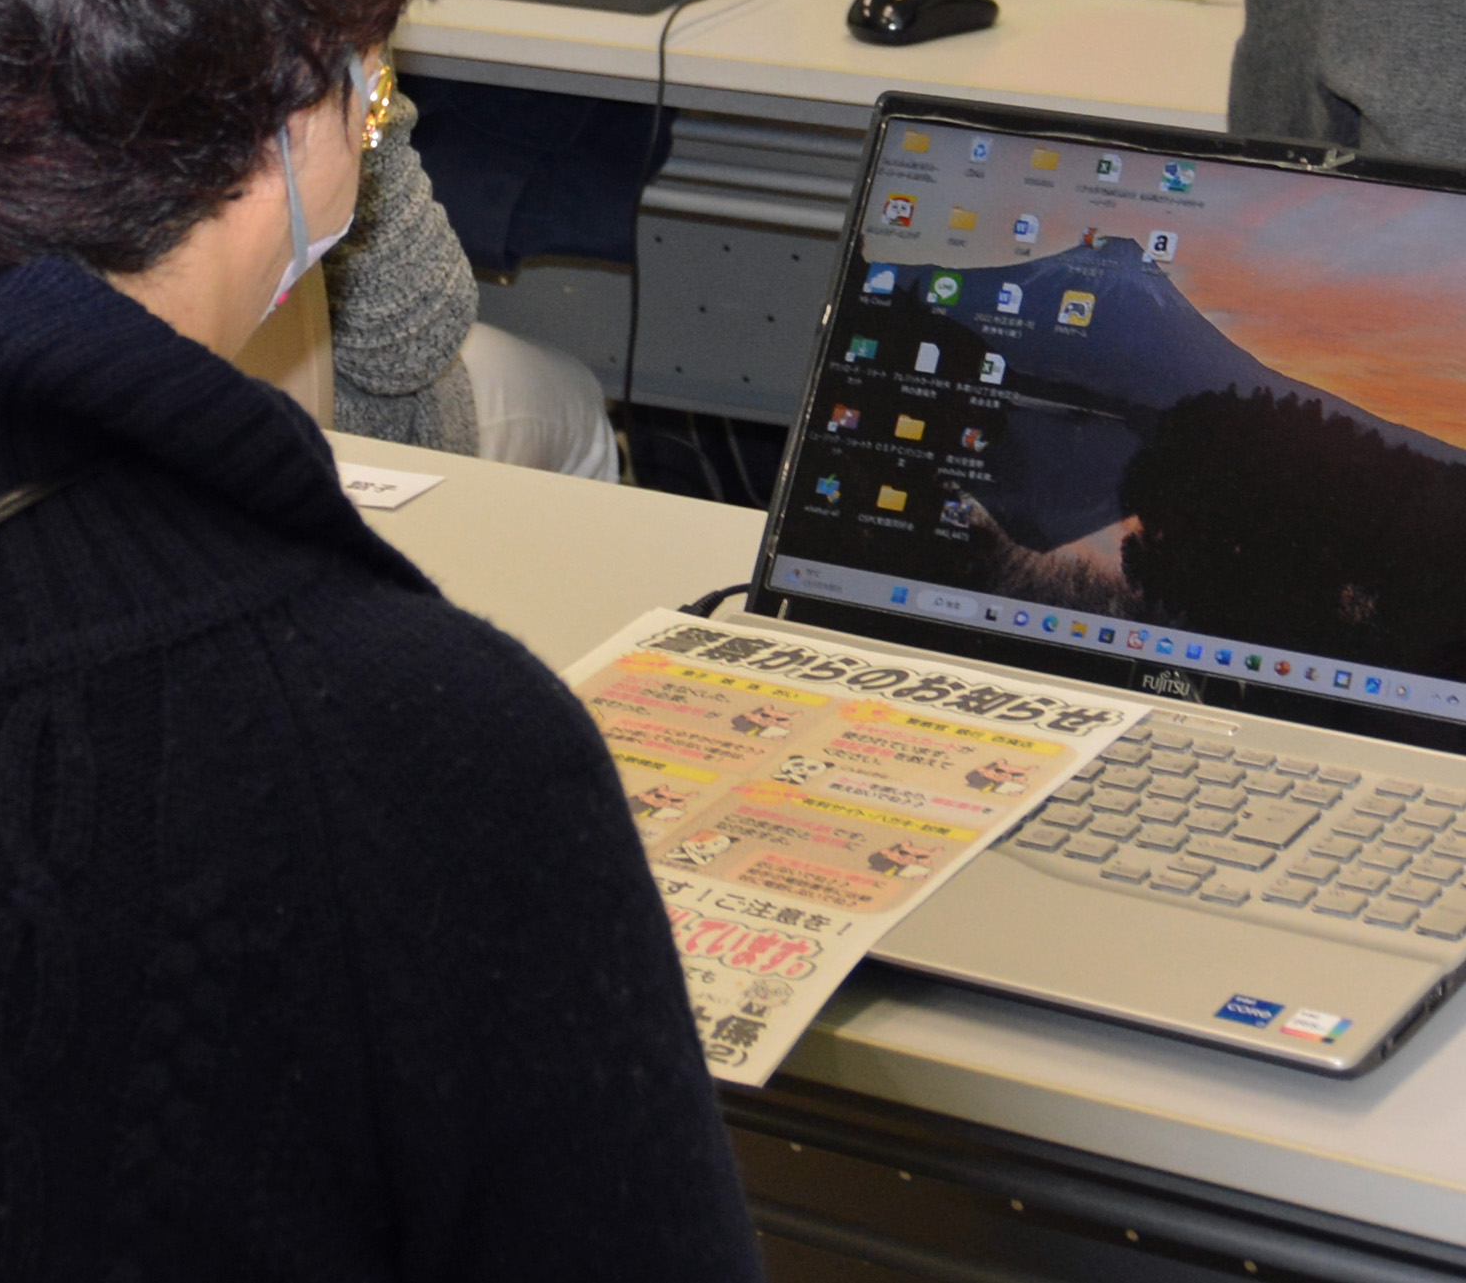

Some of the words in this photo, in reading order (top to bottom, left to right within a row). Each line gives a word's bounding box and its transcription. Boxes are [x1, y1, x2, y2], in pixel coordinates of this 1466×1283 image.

[644, 625, 1116, 734] 警察からのお知らせ
[1141, 673, 1191, 698] FUJITSU
